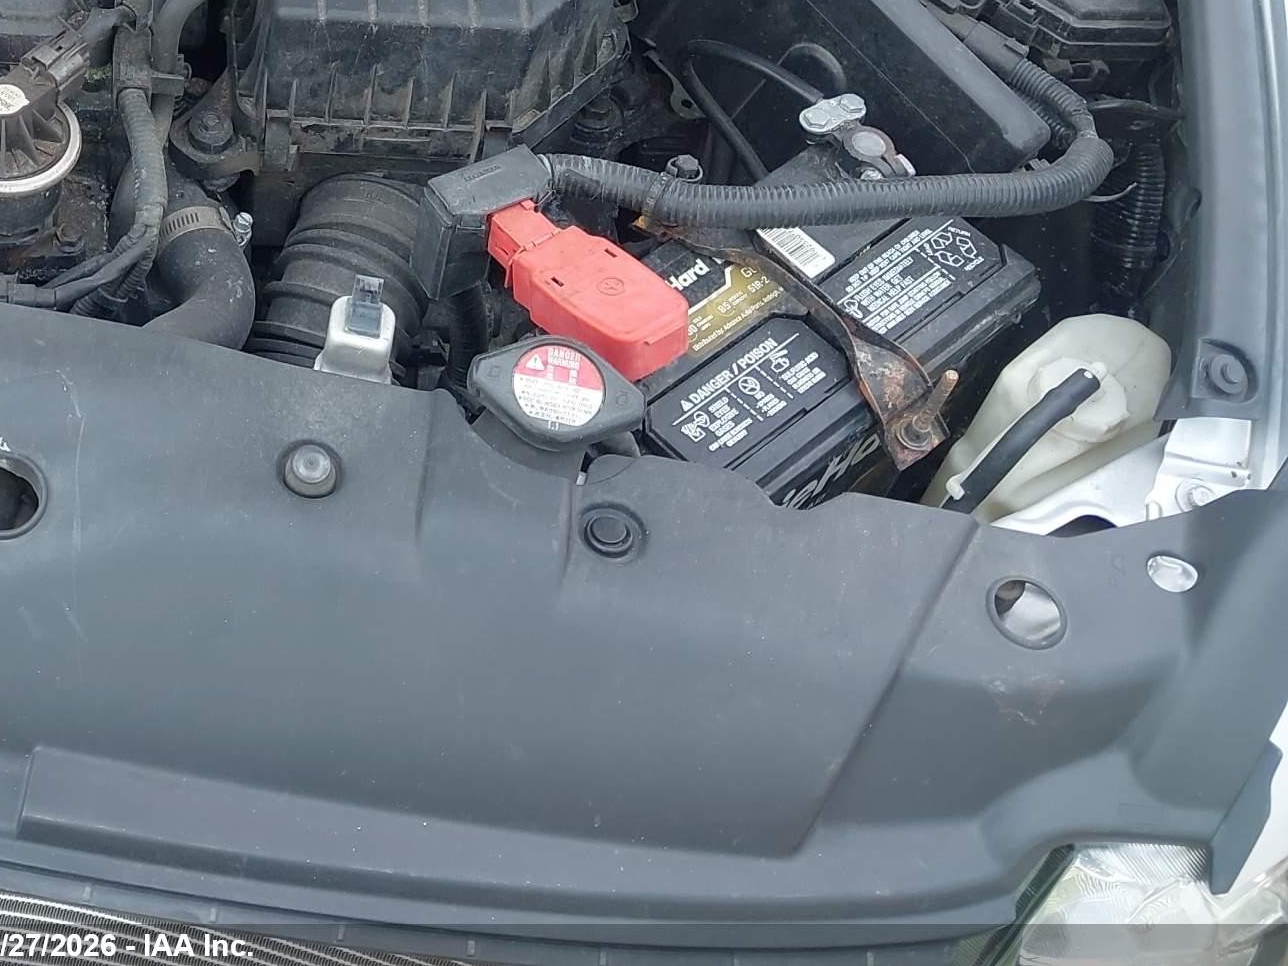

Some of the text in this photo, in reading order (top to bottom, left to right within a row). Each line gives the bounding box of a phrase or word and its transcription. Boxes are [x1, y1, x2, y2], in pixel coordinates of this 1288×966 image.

[664, 258, 711, 291] Hard
[688, 368, 734, 405] DANGER
[737, 337, 778, 369] POISON
[708, 396, 729, 413] SHIELD
